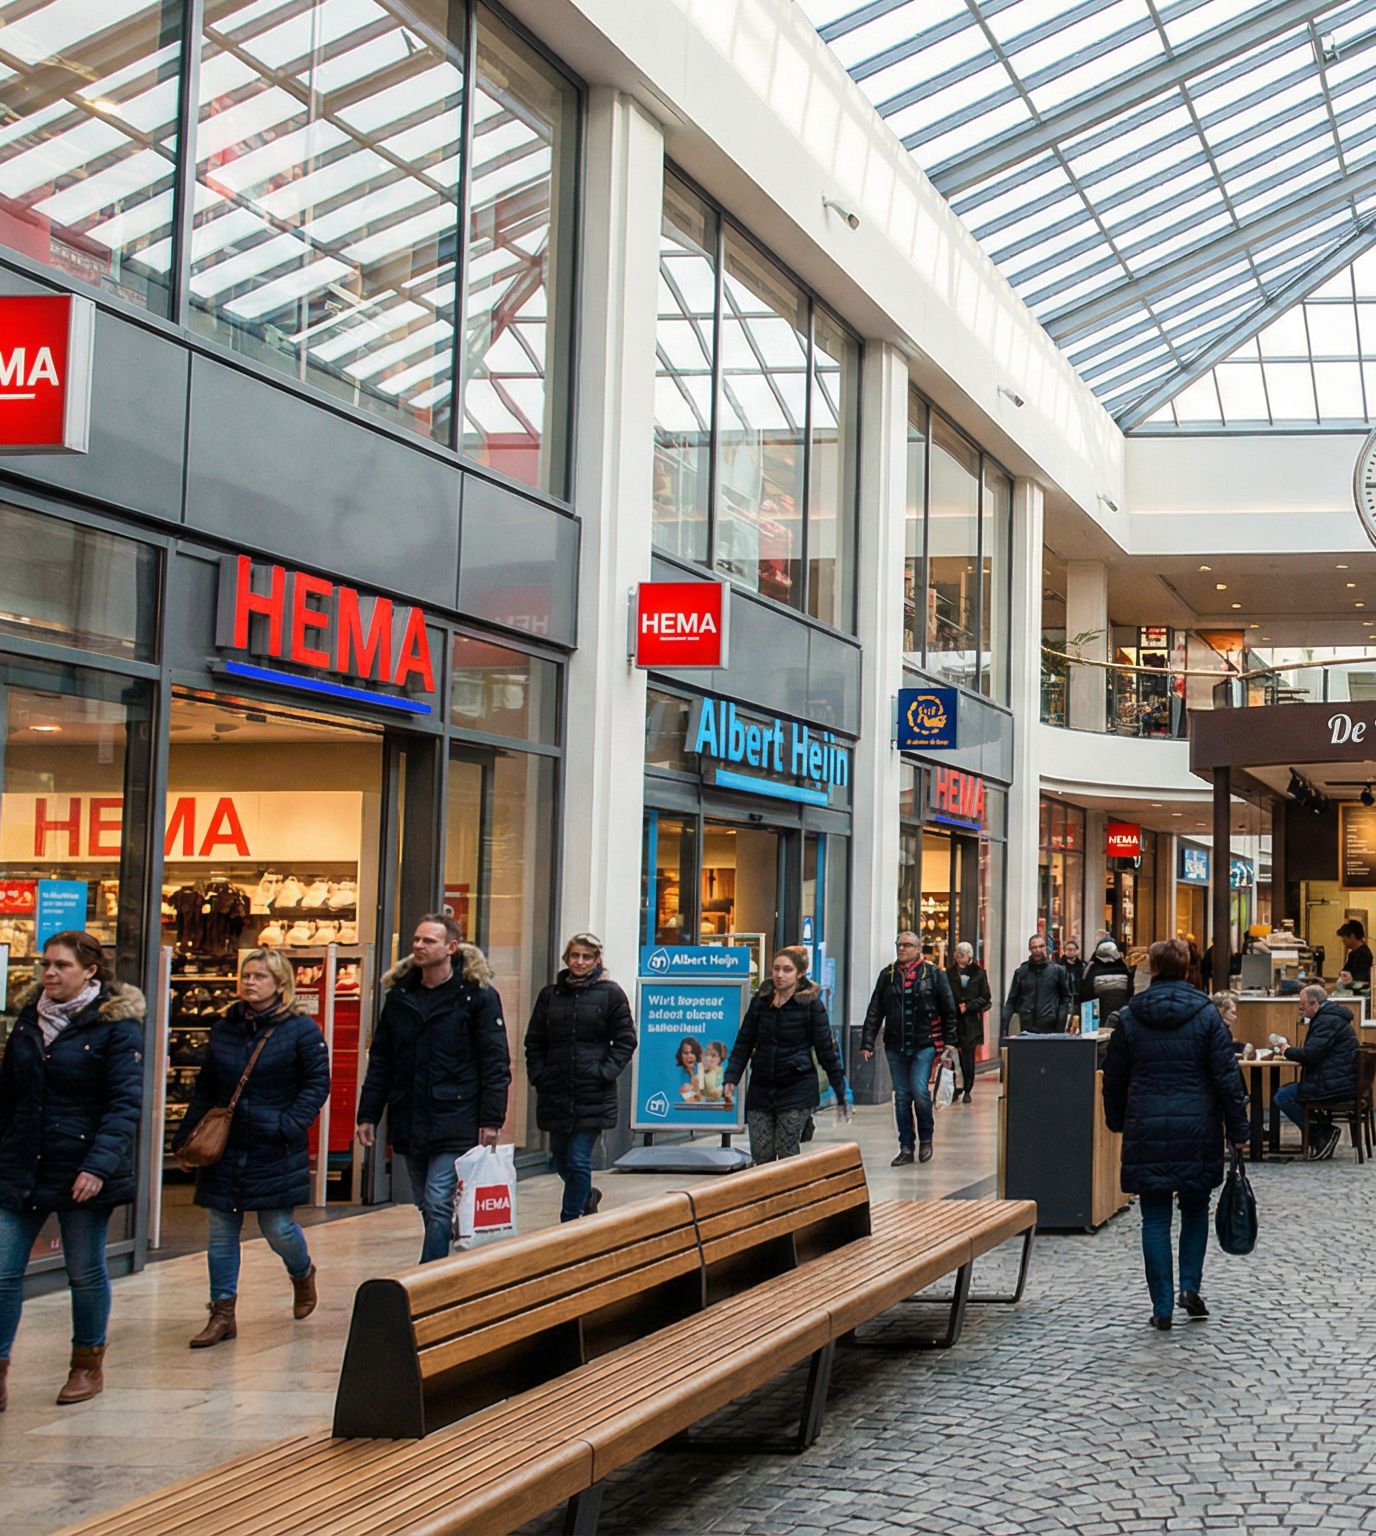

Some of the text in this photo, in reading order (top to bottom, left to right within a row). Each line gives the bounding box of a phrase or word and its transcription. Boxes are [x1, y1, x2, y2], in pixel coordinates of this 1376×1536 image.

[233, 553, 436, 693] HEMA
[642, 612, 717, 634] HEMA
[695, 696, 848, 794] Albert Heijn
[1328, 713, 1366, 744] De
[935, 766, 986, 822] HEMA
